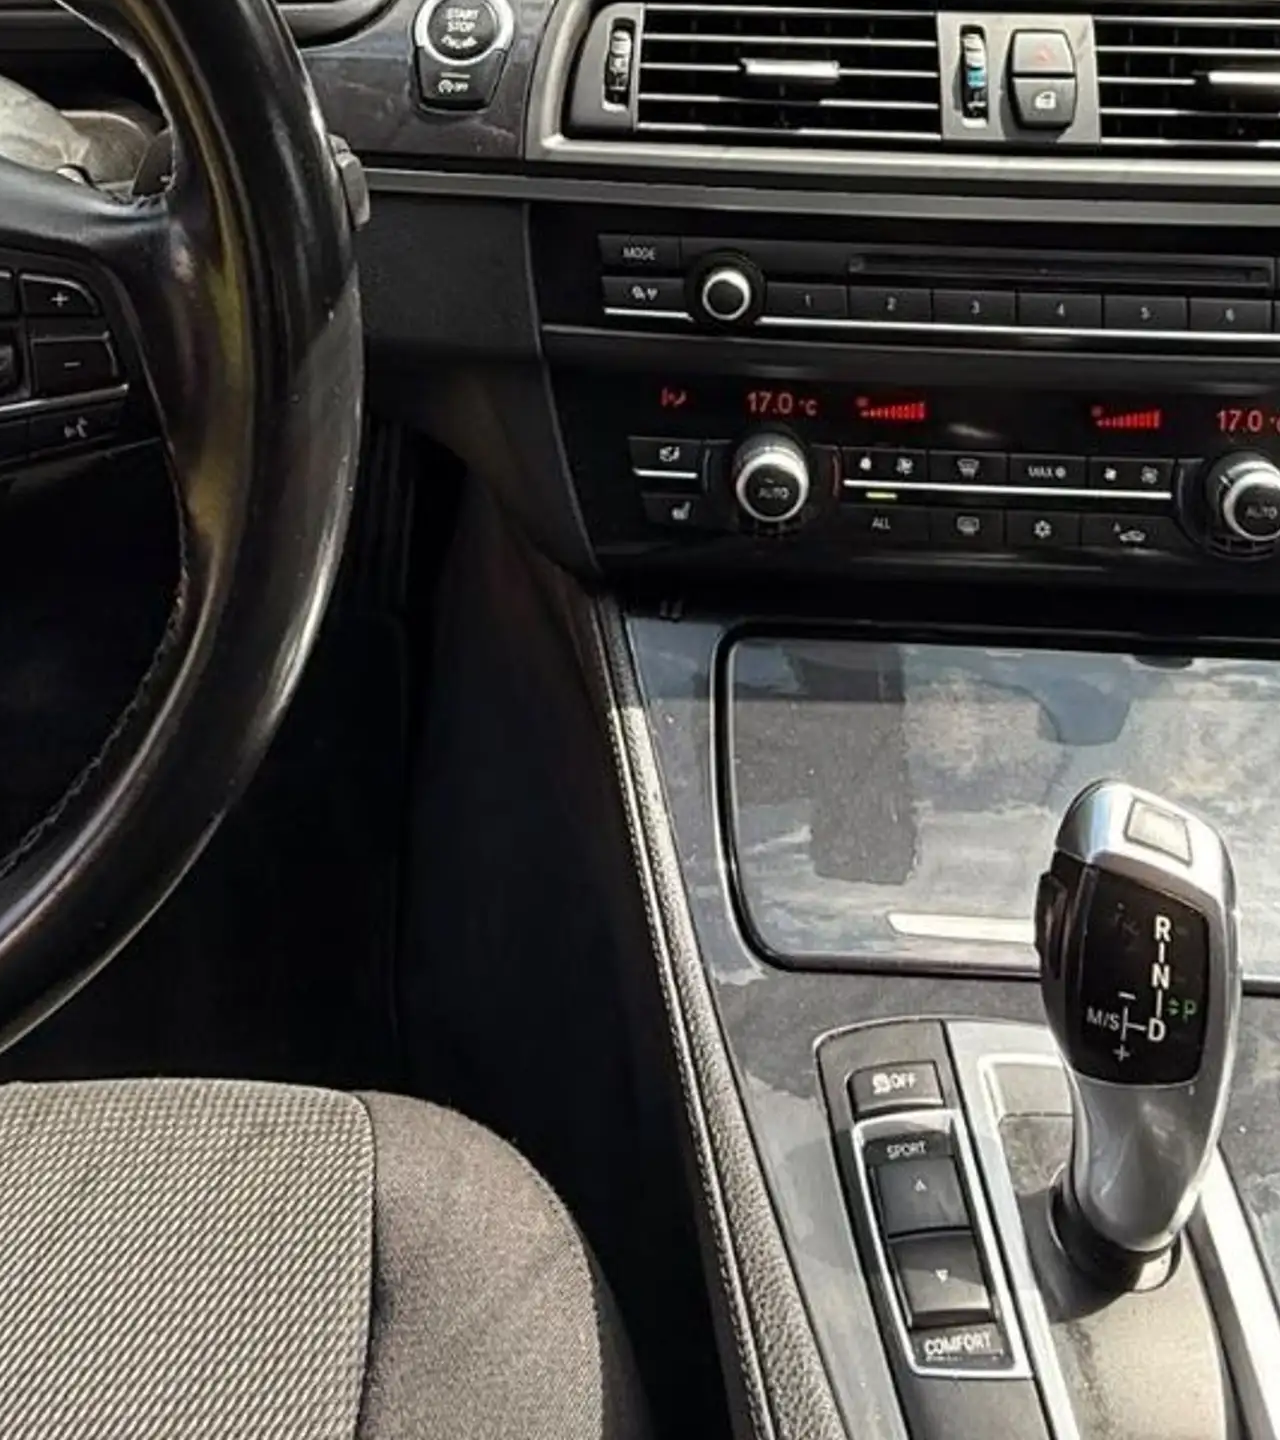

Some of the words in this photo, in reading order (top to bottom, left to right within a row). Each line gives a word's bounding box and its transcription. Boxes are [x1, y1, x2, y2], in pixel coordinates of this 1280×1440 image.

[445, 7, 479, 20] START
[447, 21, 477, 33] STOP
[622, 246, 656, 261] MODE
[747, 391, 794, 414] 17.0
[757, 486, 791, 500] AUTO
[871, 517, 892, 531] ALL
[1154, 915, 1172, 942] R
[1151, 964, 1170, 990] N
[1085, 1006, 1120, 1032] M/S
[1182, 999, 1197, 1022] P
[1147, 1017, 1167, 1043] D
[889, 1072, 917, 1090] OFF
[886, 1140, 927, 1160] SPORT
[924, 1330, 992, 1356] COMFORT
